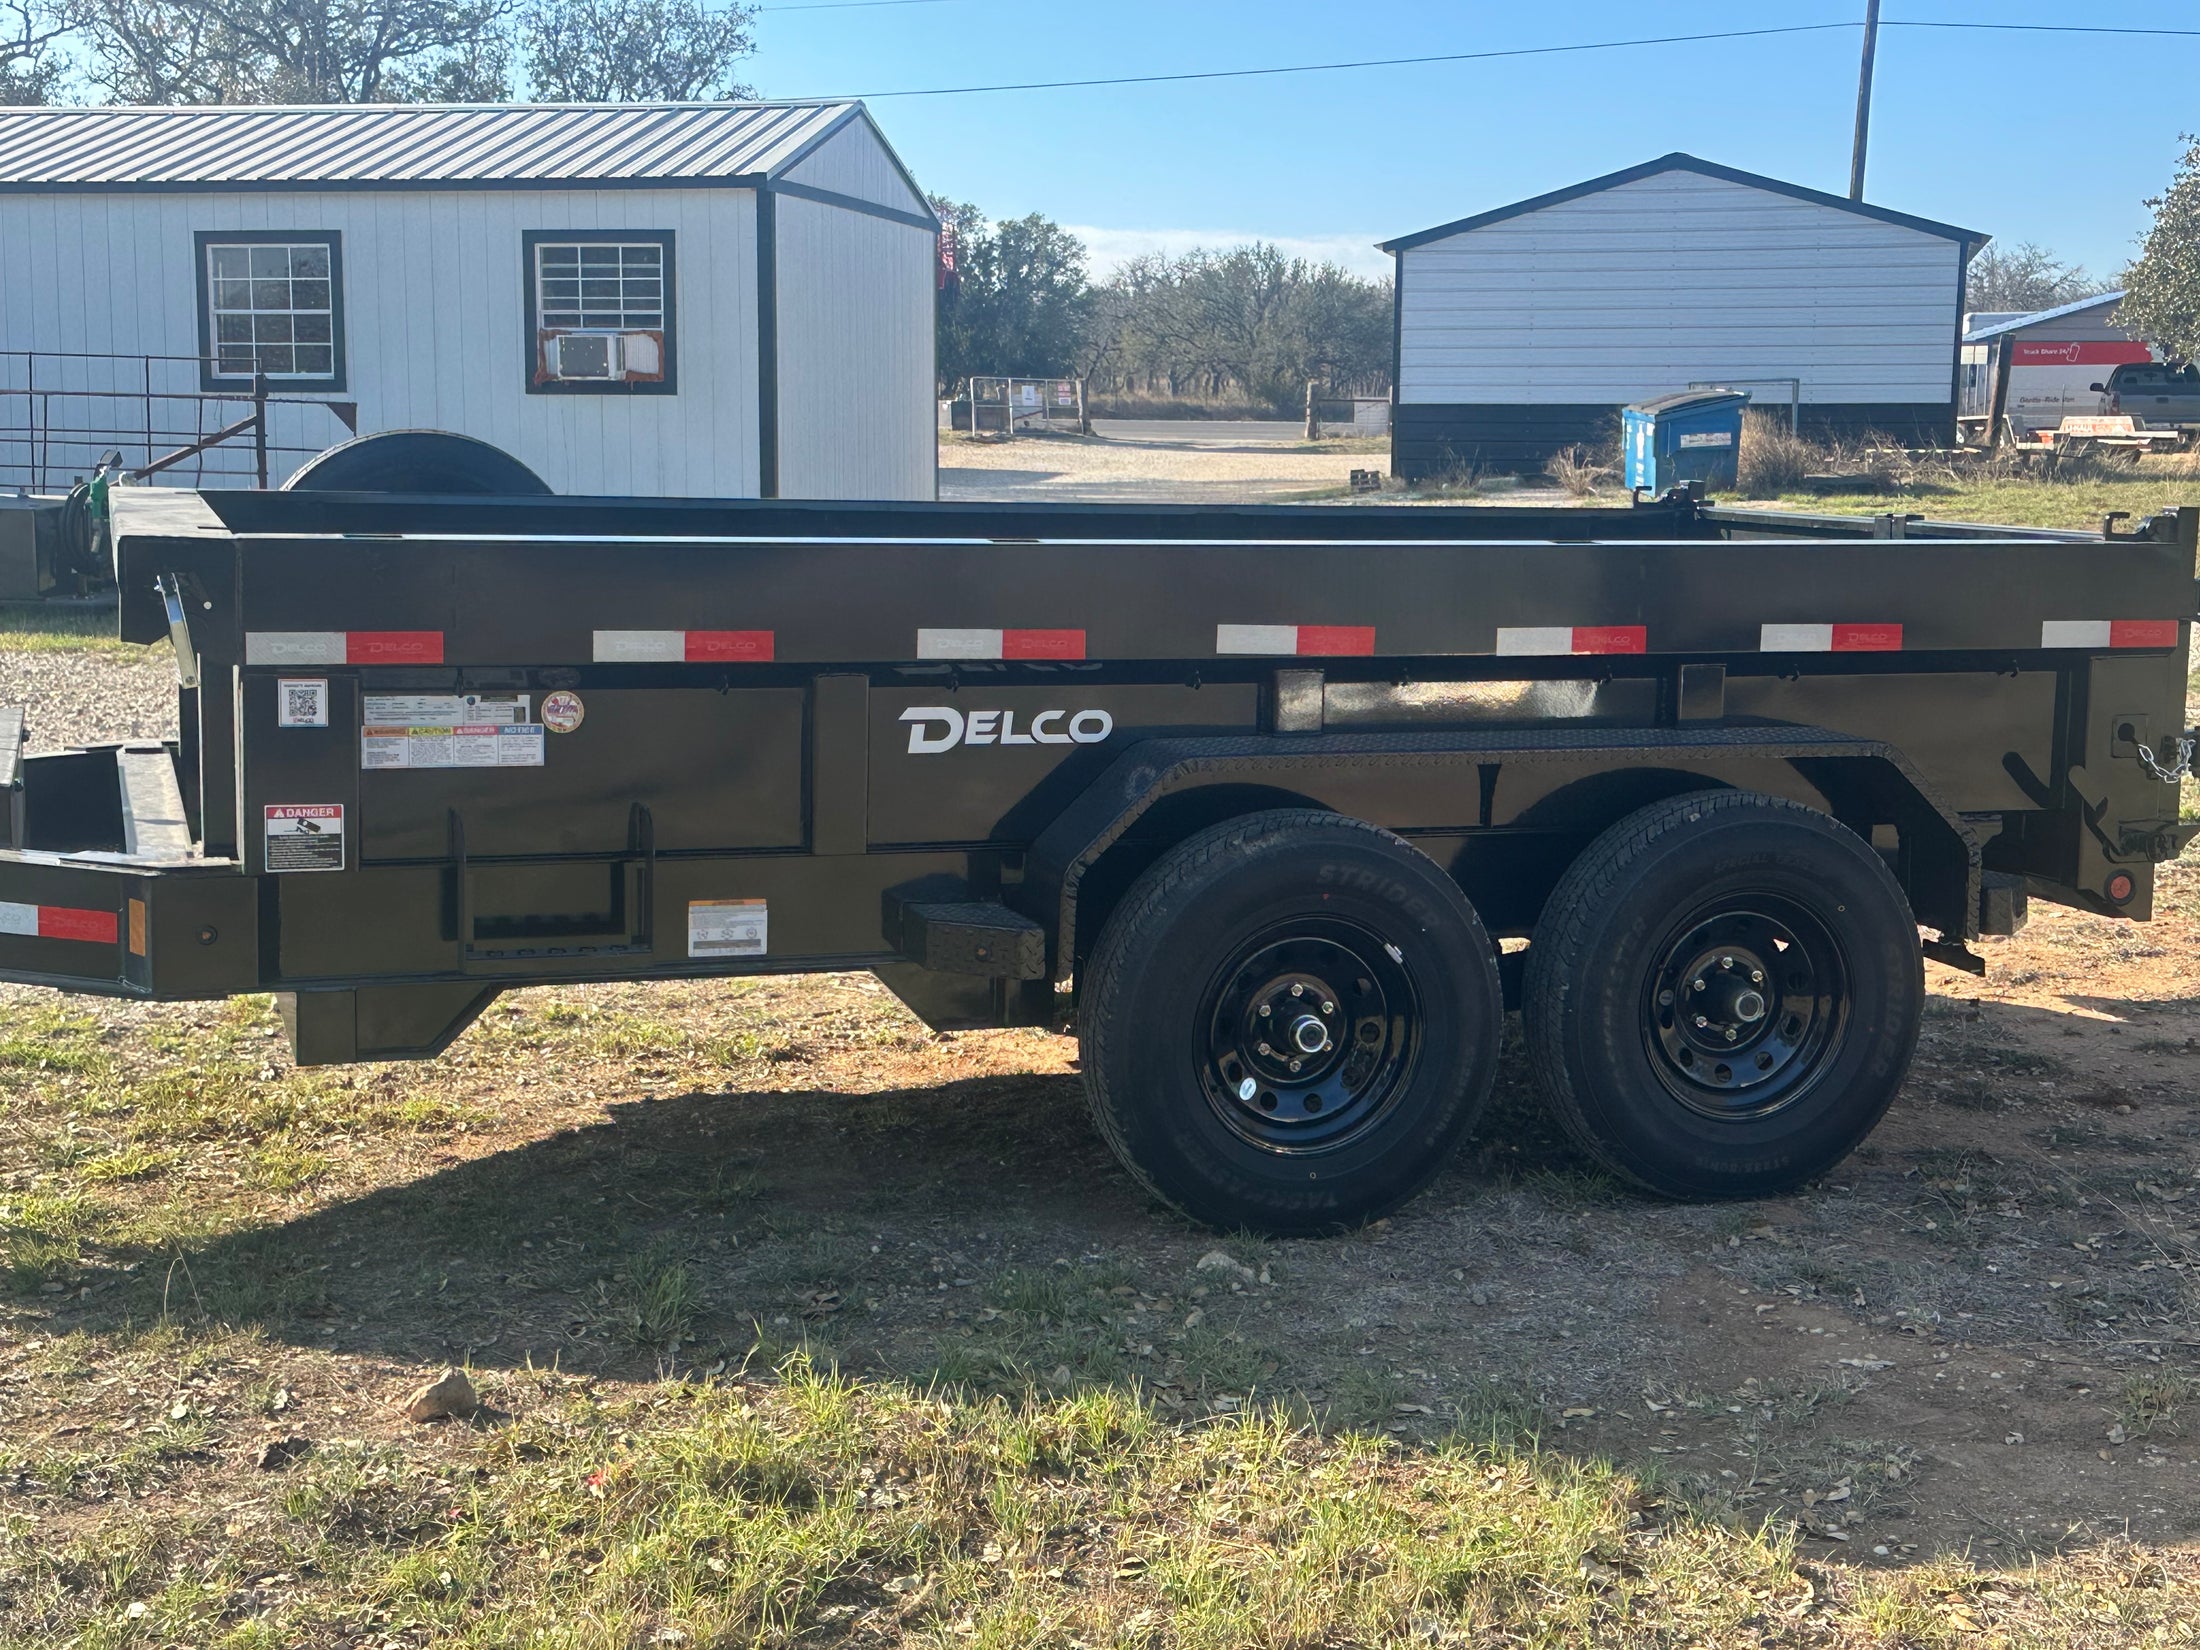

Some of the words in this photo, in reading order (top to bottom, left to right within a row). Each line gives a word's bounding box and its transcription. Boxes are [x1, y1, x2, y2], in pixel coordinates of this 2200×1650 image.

[270, 643, 328, 655] DELCO
[367, 642, 424, 654] DELCO
[898, 706, 1114, 754] DELCO
[286, 807, 335, 818] DANGER
